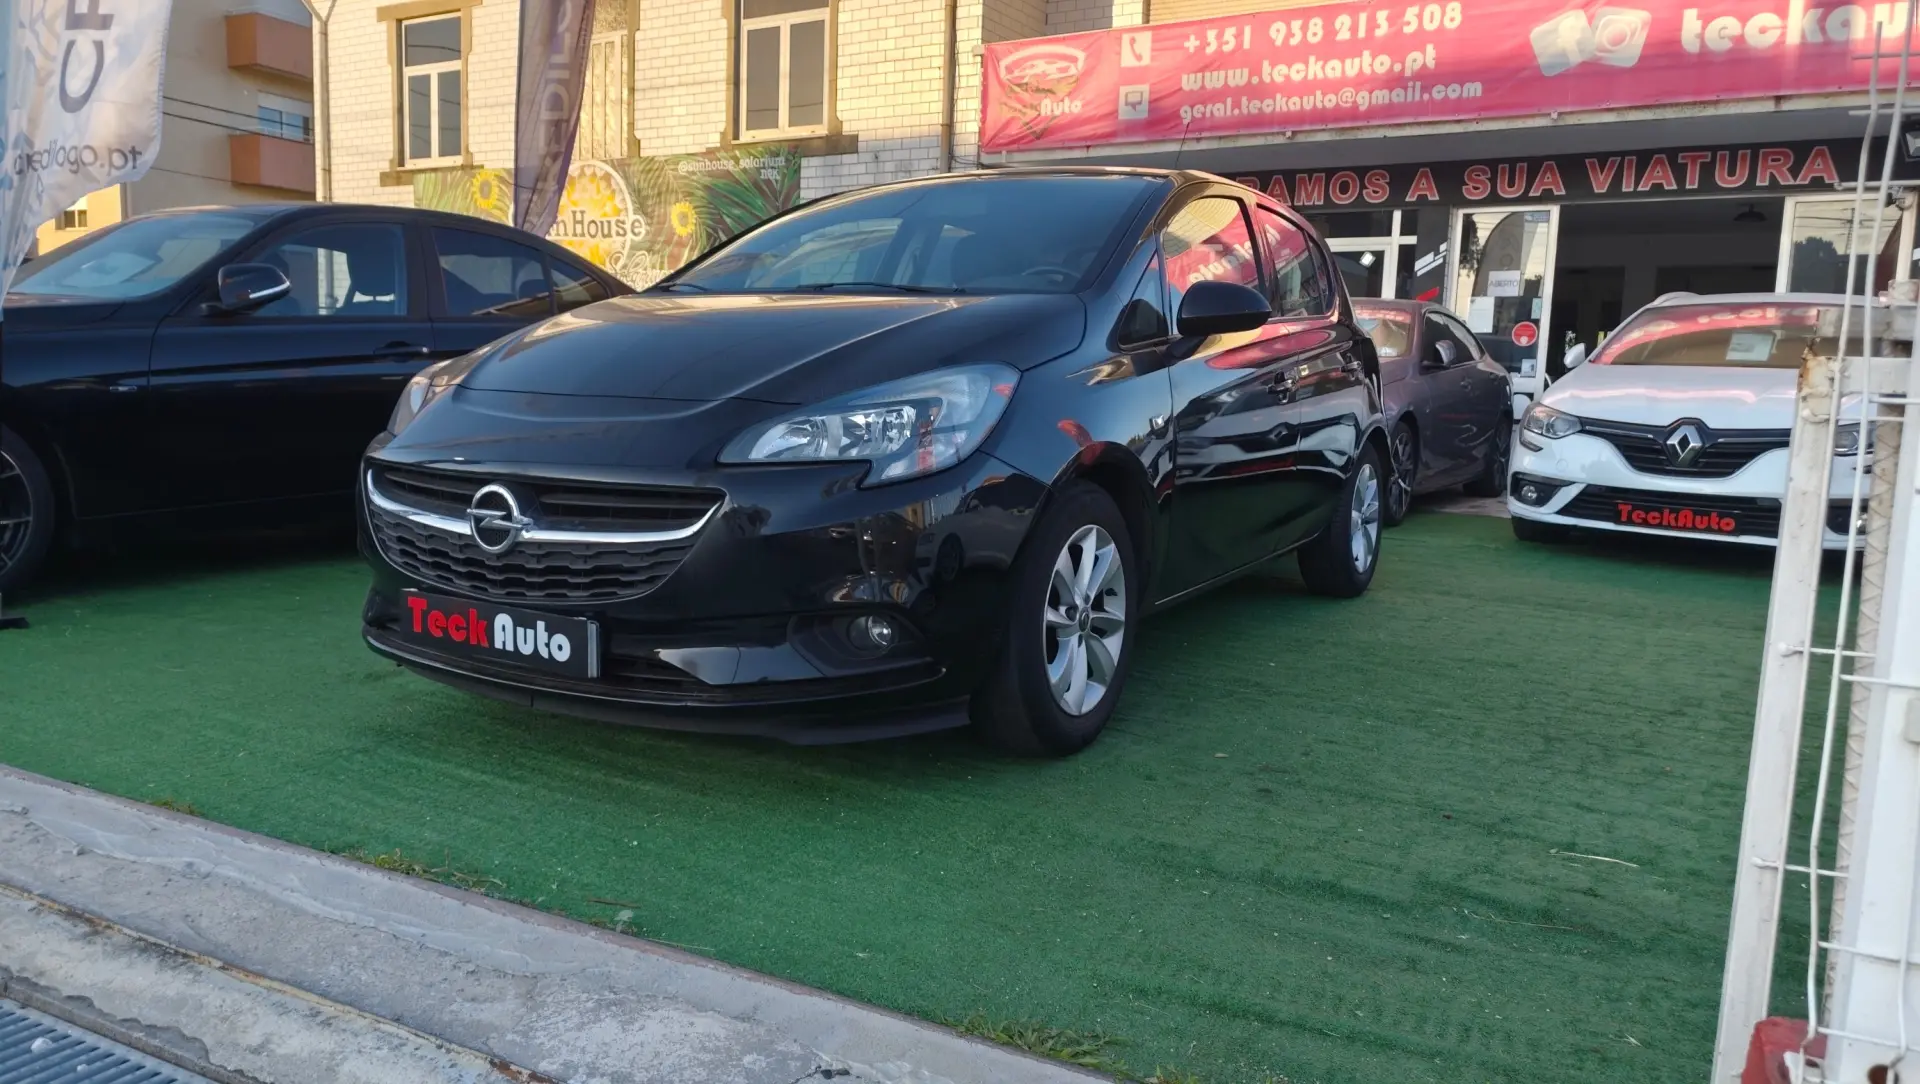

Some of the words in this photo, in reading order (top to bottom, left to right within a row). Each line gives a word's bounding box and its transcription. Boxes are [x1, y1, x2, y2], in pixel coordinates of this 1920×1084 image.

[1183, 24, 1252, 54] +351
[1269, 16, 1324, 47] 938
[1333, 9, 1390, 41] 213
[1402, 1, 1462, 34] 508
[1681, 0, 1912, 54] teckau
[1181, 43, 1437, 91] www.teckauto.pt
[1040, 96, 1082, 117] Auto
[1180, 80, 1482, 125] geral.teckauto@gmail.com
[1404, 167, 1440, 202] A
[1461, 161, 1566, 200] SUA
[1584, 145, 1841, 194] VIATURA
[1617, 503, 1736, 532] TeckAuto
[407, 595, 571, 662] TeckAuto
